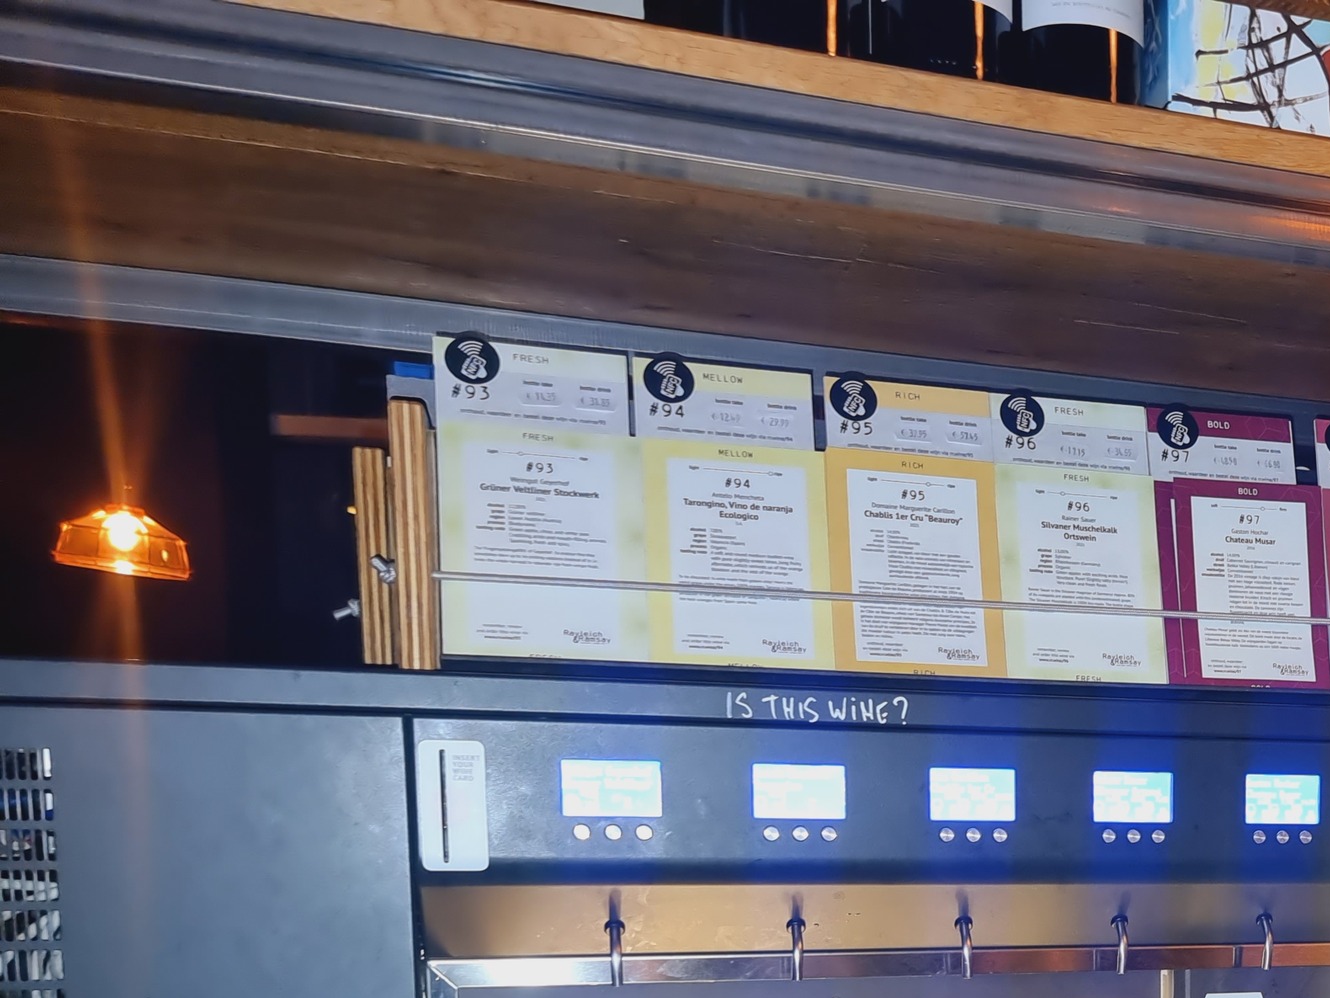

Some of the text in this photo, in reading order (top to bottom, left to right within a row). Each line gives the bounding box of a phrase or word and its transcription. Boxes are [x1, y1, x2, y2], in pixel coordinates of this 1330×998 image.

[513, 353, 549, 364] FRESH
[702, 373, 743, 384] MELLOW
[451, 383, 490, 400] #93
[895, 392, 920, 400] RICH
[649, 402, 685, 417] #94
[1054, 406, 1084, 416] FRESH
[839, 420, 873, 435] #95
[1207, 420, 1230, 430] BOLD
[522, 433, 554, 442] FRESH
[1005, 435, 1036, 450] #96
[718, 449, 753, 458] MELLOW
[1161, 449, 1190, 463] #97
[526, 462, 554, 473] #93
[902, 461, 924, 469] RICH
[725, 477, 751, 488] #94
[1063, 473, 1089, 482] FRESH
[554, 488, 600, 499] Stockwerk
[901, 489, 925, 501] #95
[1237, 488, 1258, 496] BOLD
[683, 498, 728, 509] Tarongino,
[729, 501, 748, 510] Vino
[763, 505, 793, 514] naranja
[1067, 500, 1090, 512] #96
[719, 511, 759, 521] Ecologico
[864, 510, 893, 520] Chablis
[910, 513, 924, 522] Cru
[1239, 514, 1260, 524] #97
[1041, 521, 1118, 534] Silvaner Muschelkalk
[1064, 532, 1097, 542] Ortswein
[1225, 536, 1276, 545] Chateau Musar
[726, 691, 753, 719] IS
[761, 694, 820, 723] THIS
